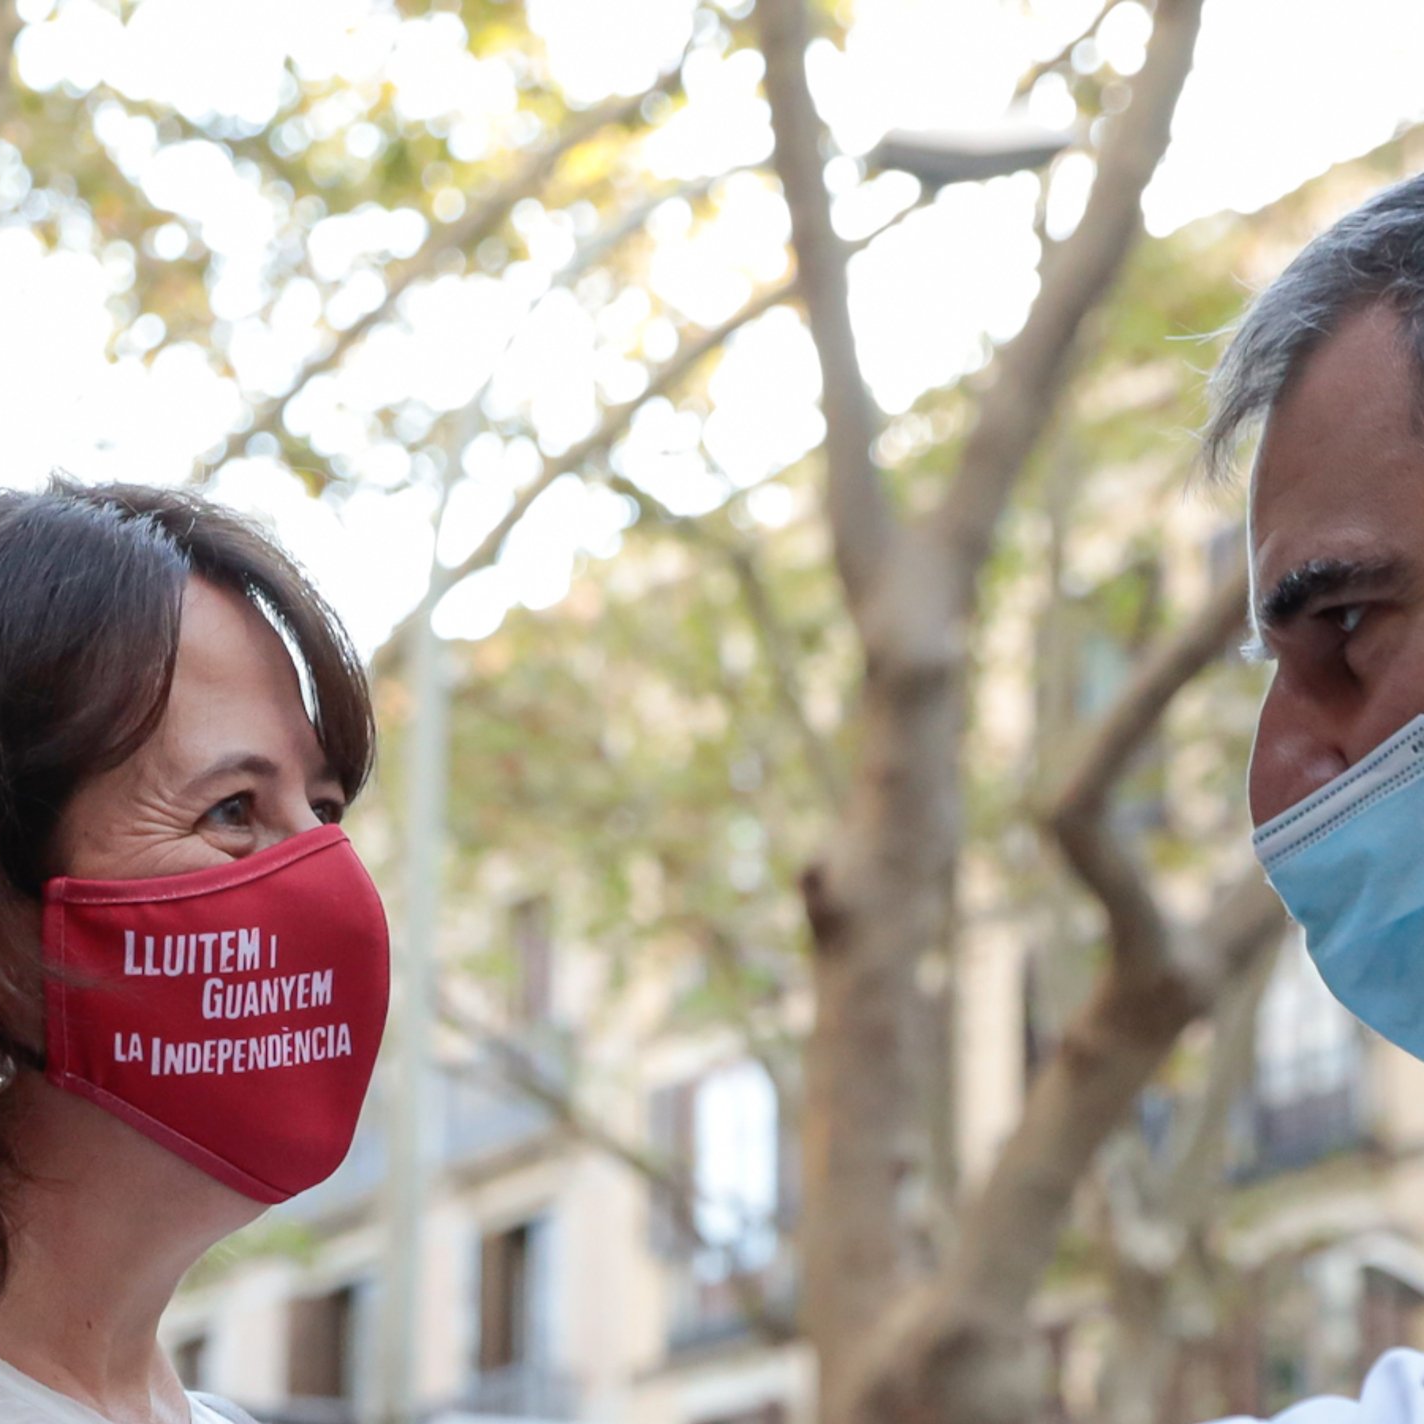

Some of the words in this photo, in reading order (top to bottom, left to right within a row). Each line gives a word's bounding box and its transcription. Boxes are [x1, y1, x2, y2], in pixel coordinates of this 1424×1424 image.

[124, 927, 260, 976] LLUITEM
[202, 969, 333, 1020] GUANYEM
[114, 1032, 143, 1062] LA
[151, 1023, 352, 1075] INDEPENDÈNCIA
